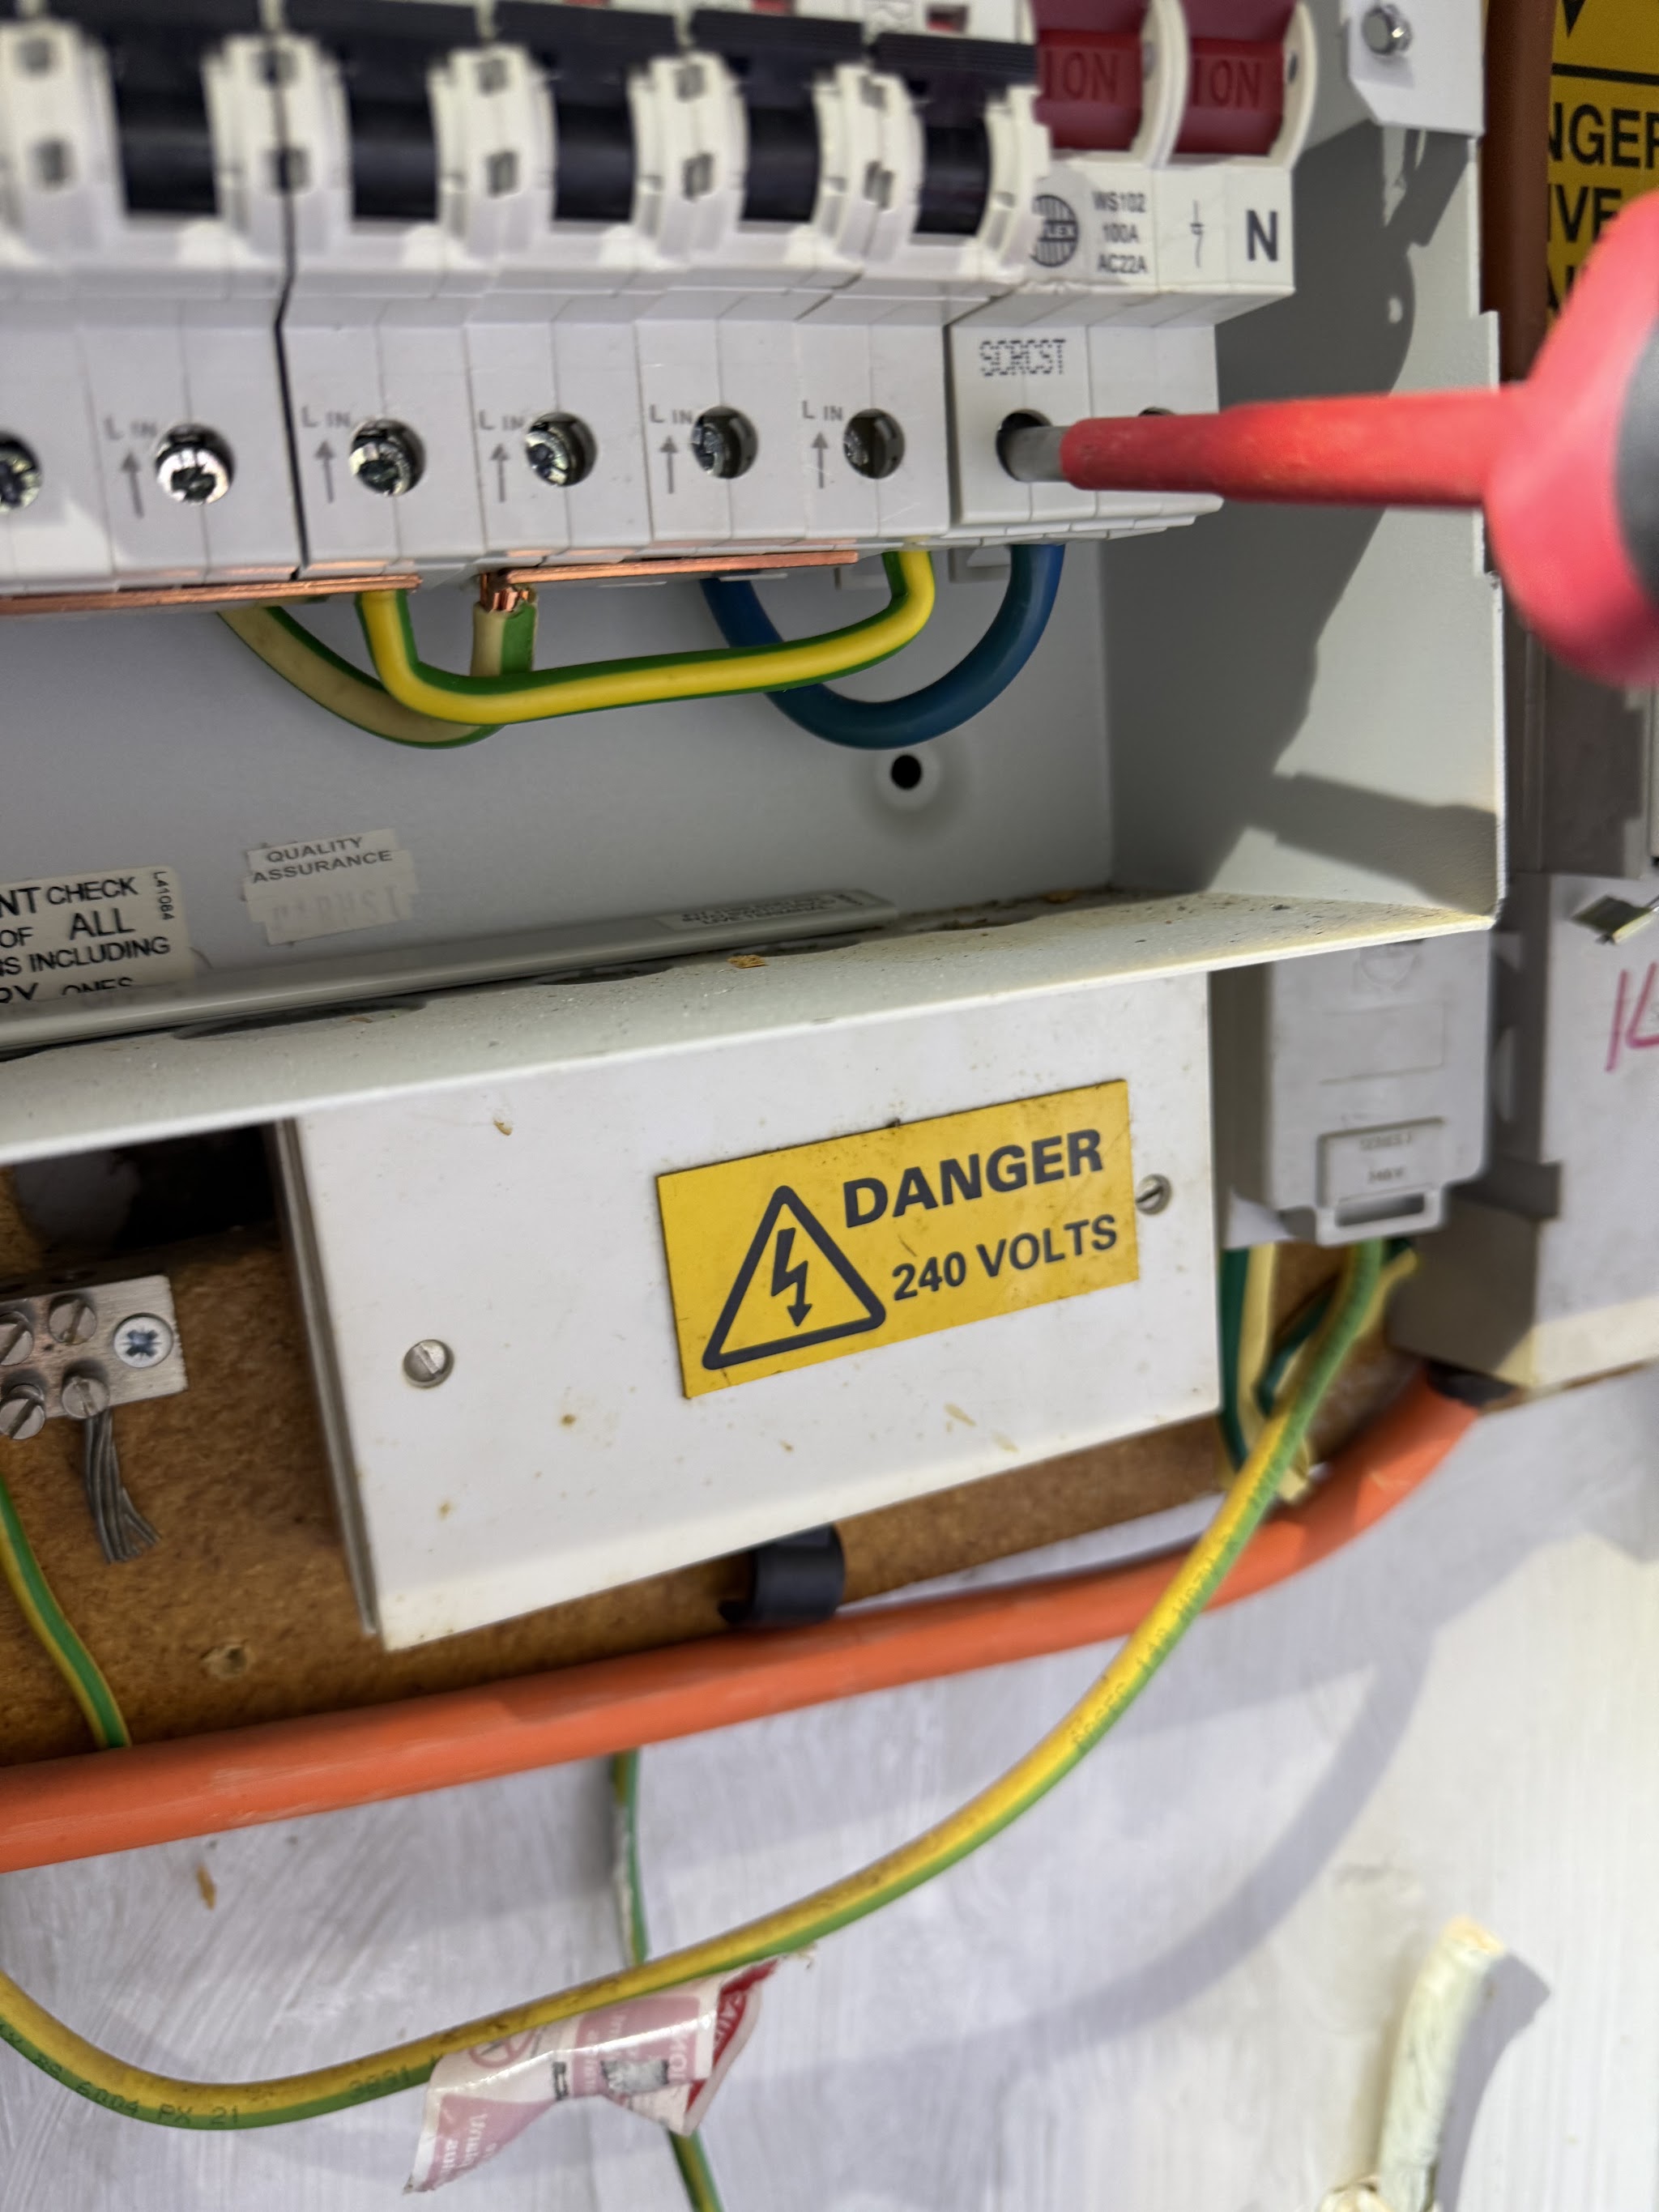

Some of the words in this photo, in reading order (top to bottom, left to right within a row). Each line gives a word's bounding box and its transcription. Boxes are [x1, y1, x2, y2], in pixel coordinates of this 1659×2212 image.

[1246, 208, 1279, 262] N
[1098, 254, 1148, 274] AC22A
[301, 406, 318, 428] L
[326, 410, 351, 428] IN
[480, 409, 495, 430] L
[650, 404, 664, 424] L
[672, 409, 693, 424] IN
[801, 399, 815, 420] L
[823, 405, 844, 421] IN
[267, 836, 362, 863] QUALITY
[253, 850, 393, 884] ASSURANCE
[47, 876, 139, 906] CHECK
[69, 907, 136, 940] ALL
[0, 956, 22, 977] S
[28, 936, 170, 974] INCLUDING
[843, 1128, 1103, 1229] DANGER
[893, 1251, 967, 1302] 240
[976, 1213, 1117, 1278] VOLTS
[211, 2104, 240, 2125] 21
